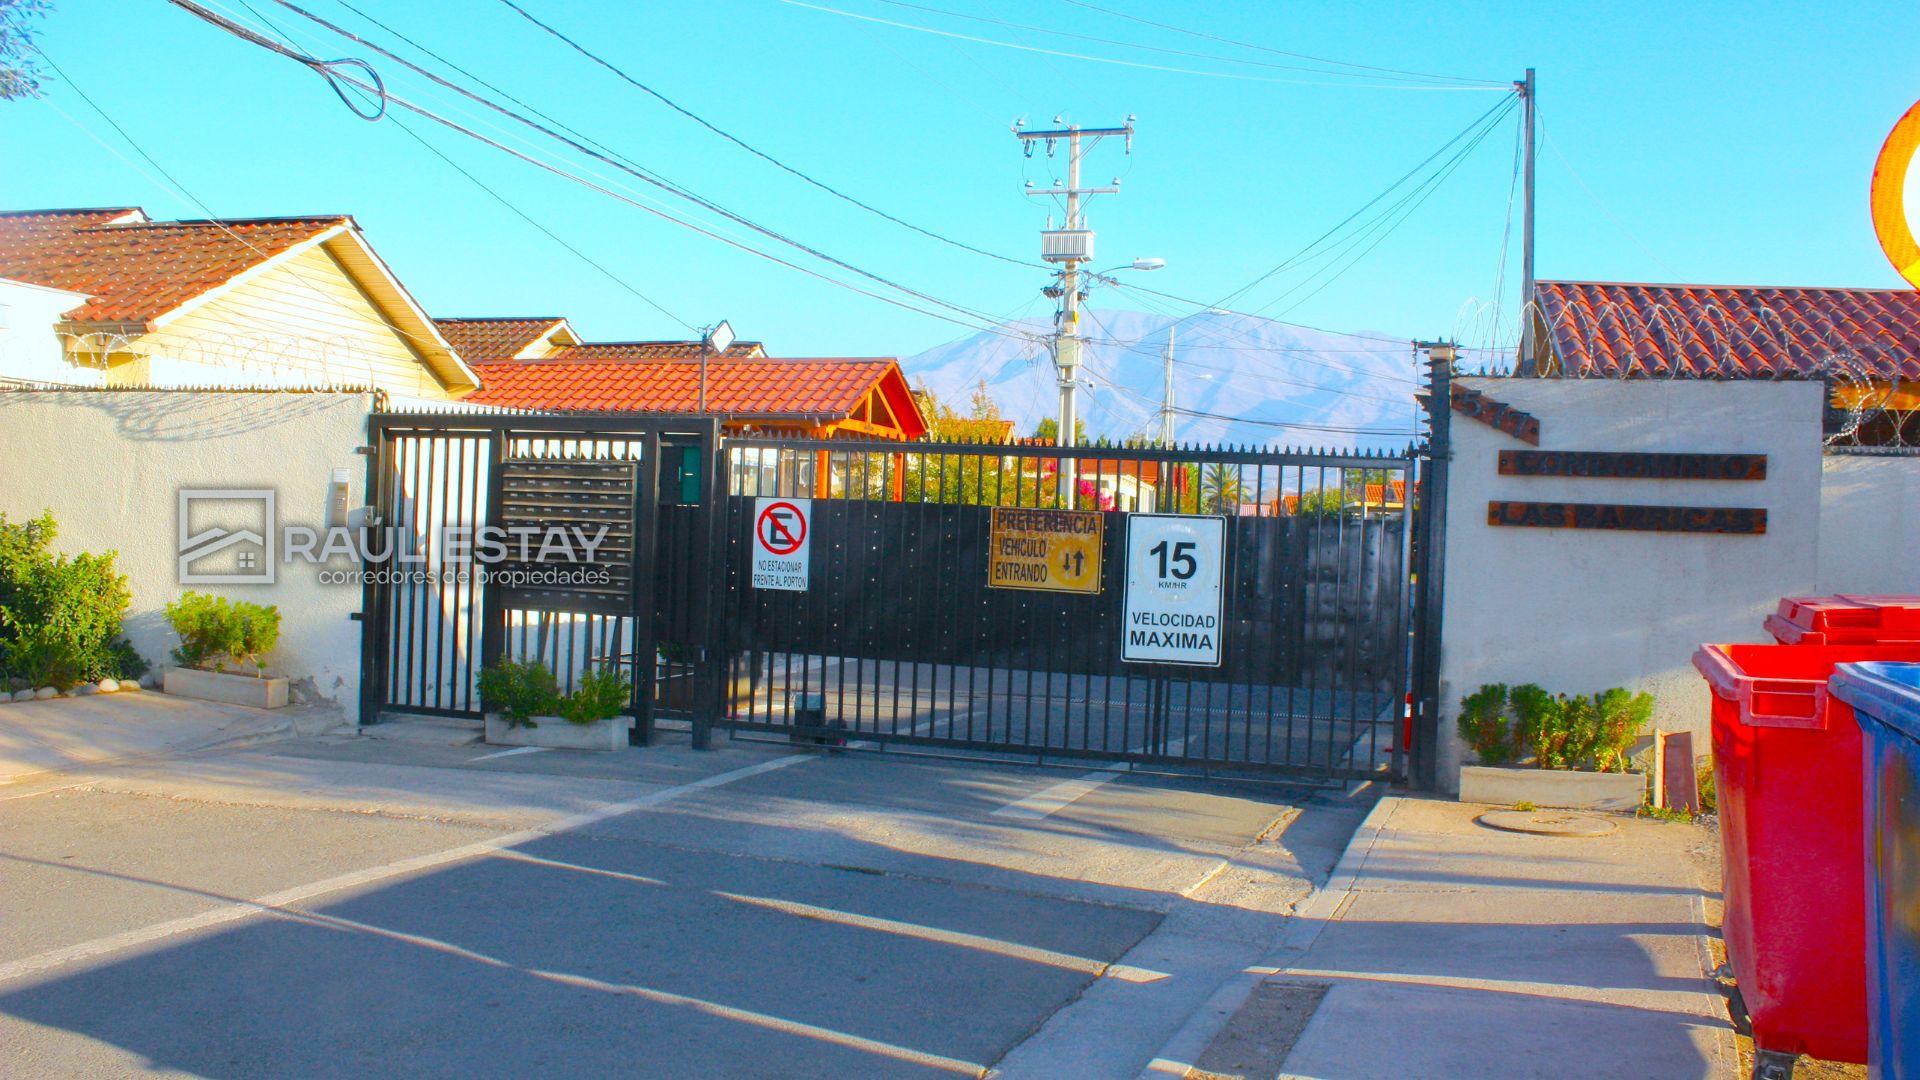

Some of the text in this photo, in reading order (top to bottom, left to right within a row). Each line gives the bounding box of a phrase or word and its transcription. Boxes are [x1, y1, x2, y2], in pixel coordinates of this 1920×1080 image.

[1515, 451, 1749, 478] CONDOMINIO
[997, 511, 1097, 535] PREFERENCIA
[1500, 502, 1755, 533] LAS BARRICAS
[1000, 538, 1047, 558] VEHICULO
[758, 560, 802, 573] NO ESTACIONAR
[1150, 540, 1197, 580] 15
[753, 574, 807, 588] FRENTE AL PORTON
[995, 562, 1048, 583] ENTRANDO
[1158, 581, 1187, 590] KM/HR
[1132, 612, 1216, 629] VELOCIDAD
[1130, 630, 1213, 651] MAXIMA
